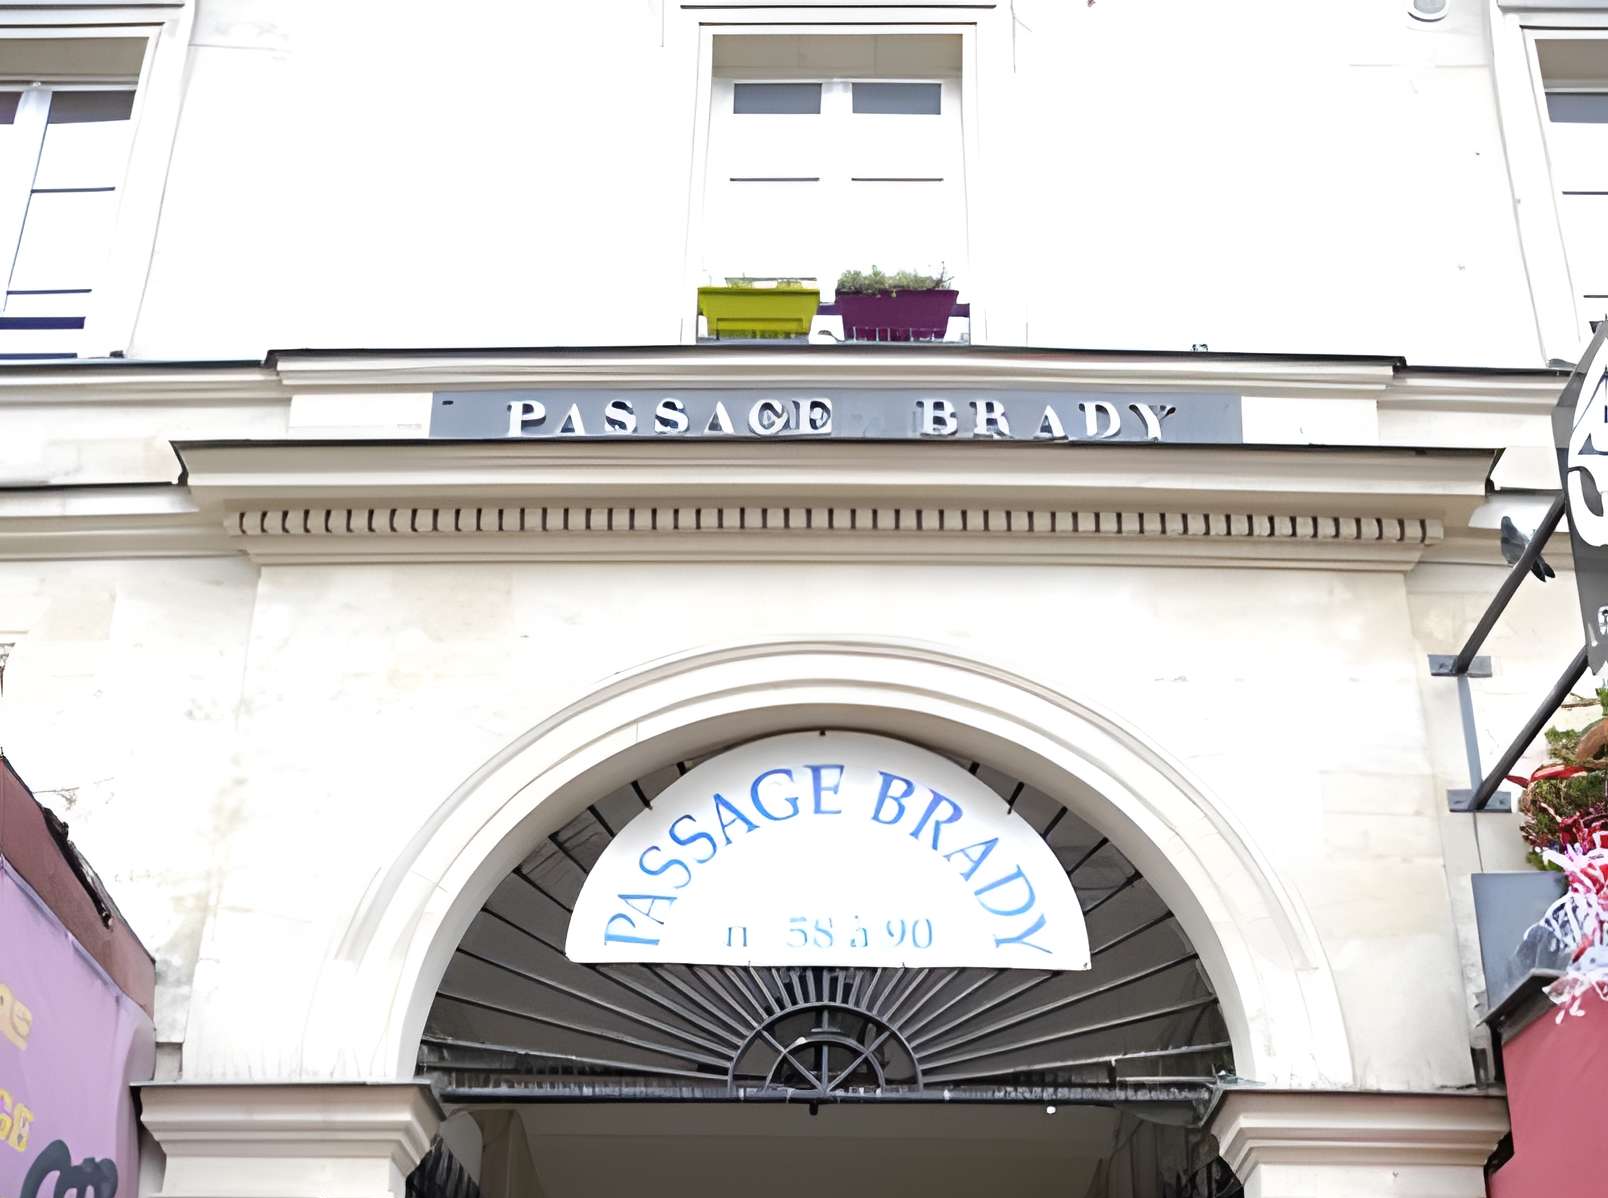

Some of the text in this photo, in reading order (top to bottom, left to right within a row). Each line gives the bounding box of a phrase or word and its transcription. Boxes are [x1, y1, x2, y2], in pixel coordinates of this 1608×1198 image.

[507, 398, 1176, 442] PASSAGE BRADY
[604, 764, 1054, 955] PASSAGE BRADY
[786, 916, 834, 948] 58
[886, 917, 933, 949] 90
